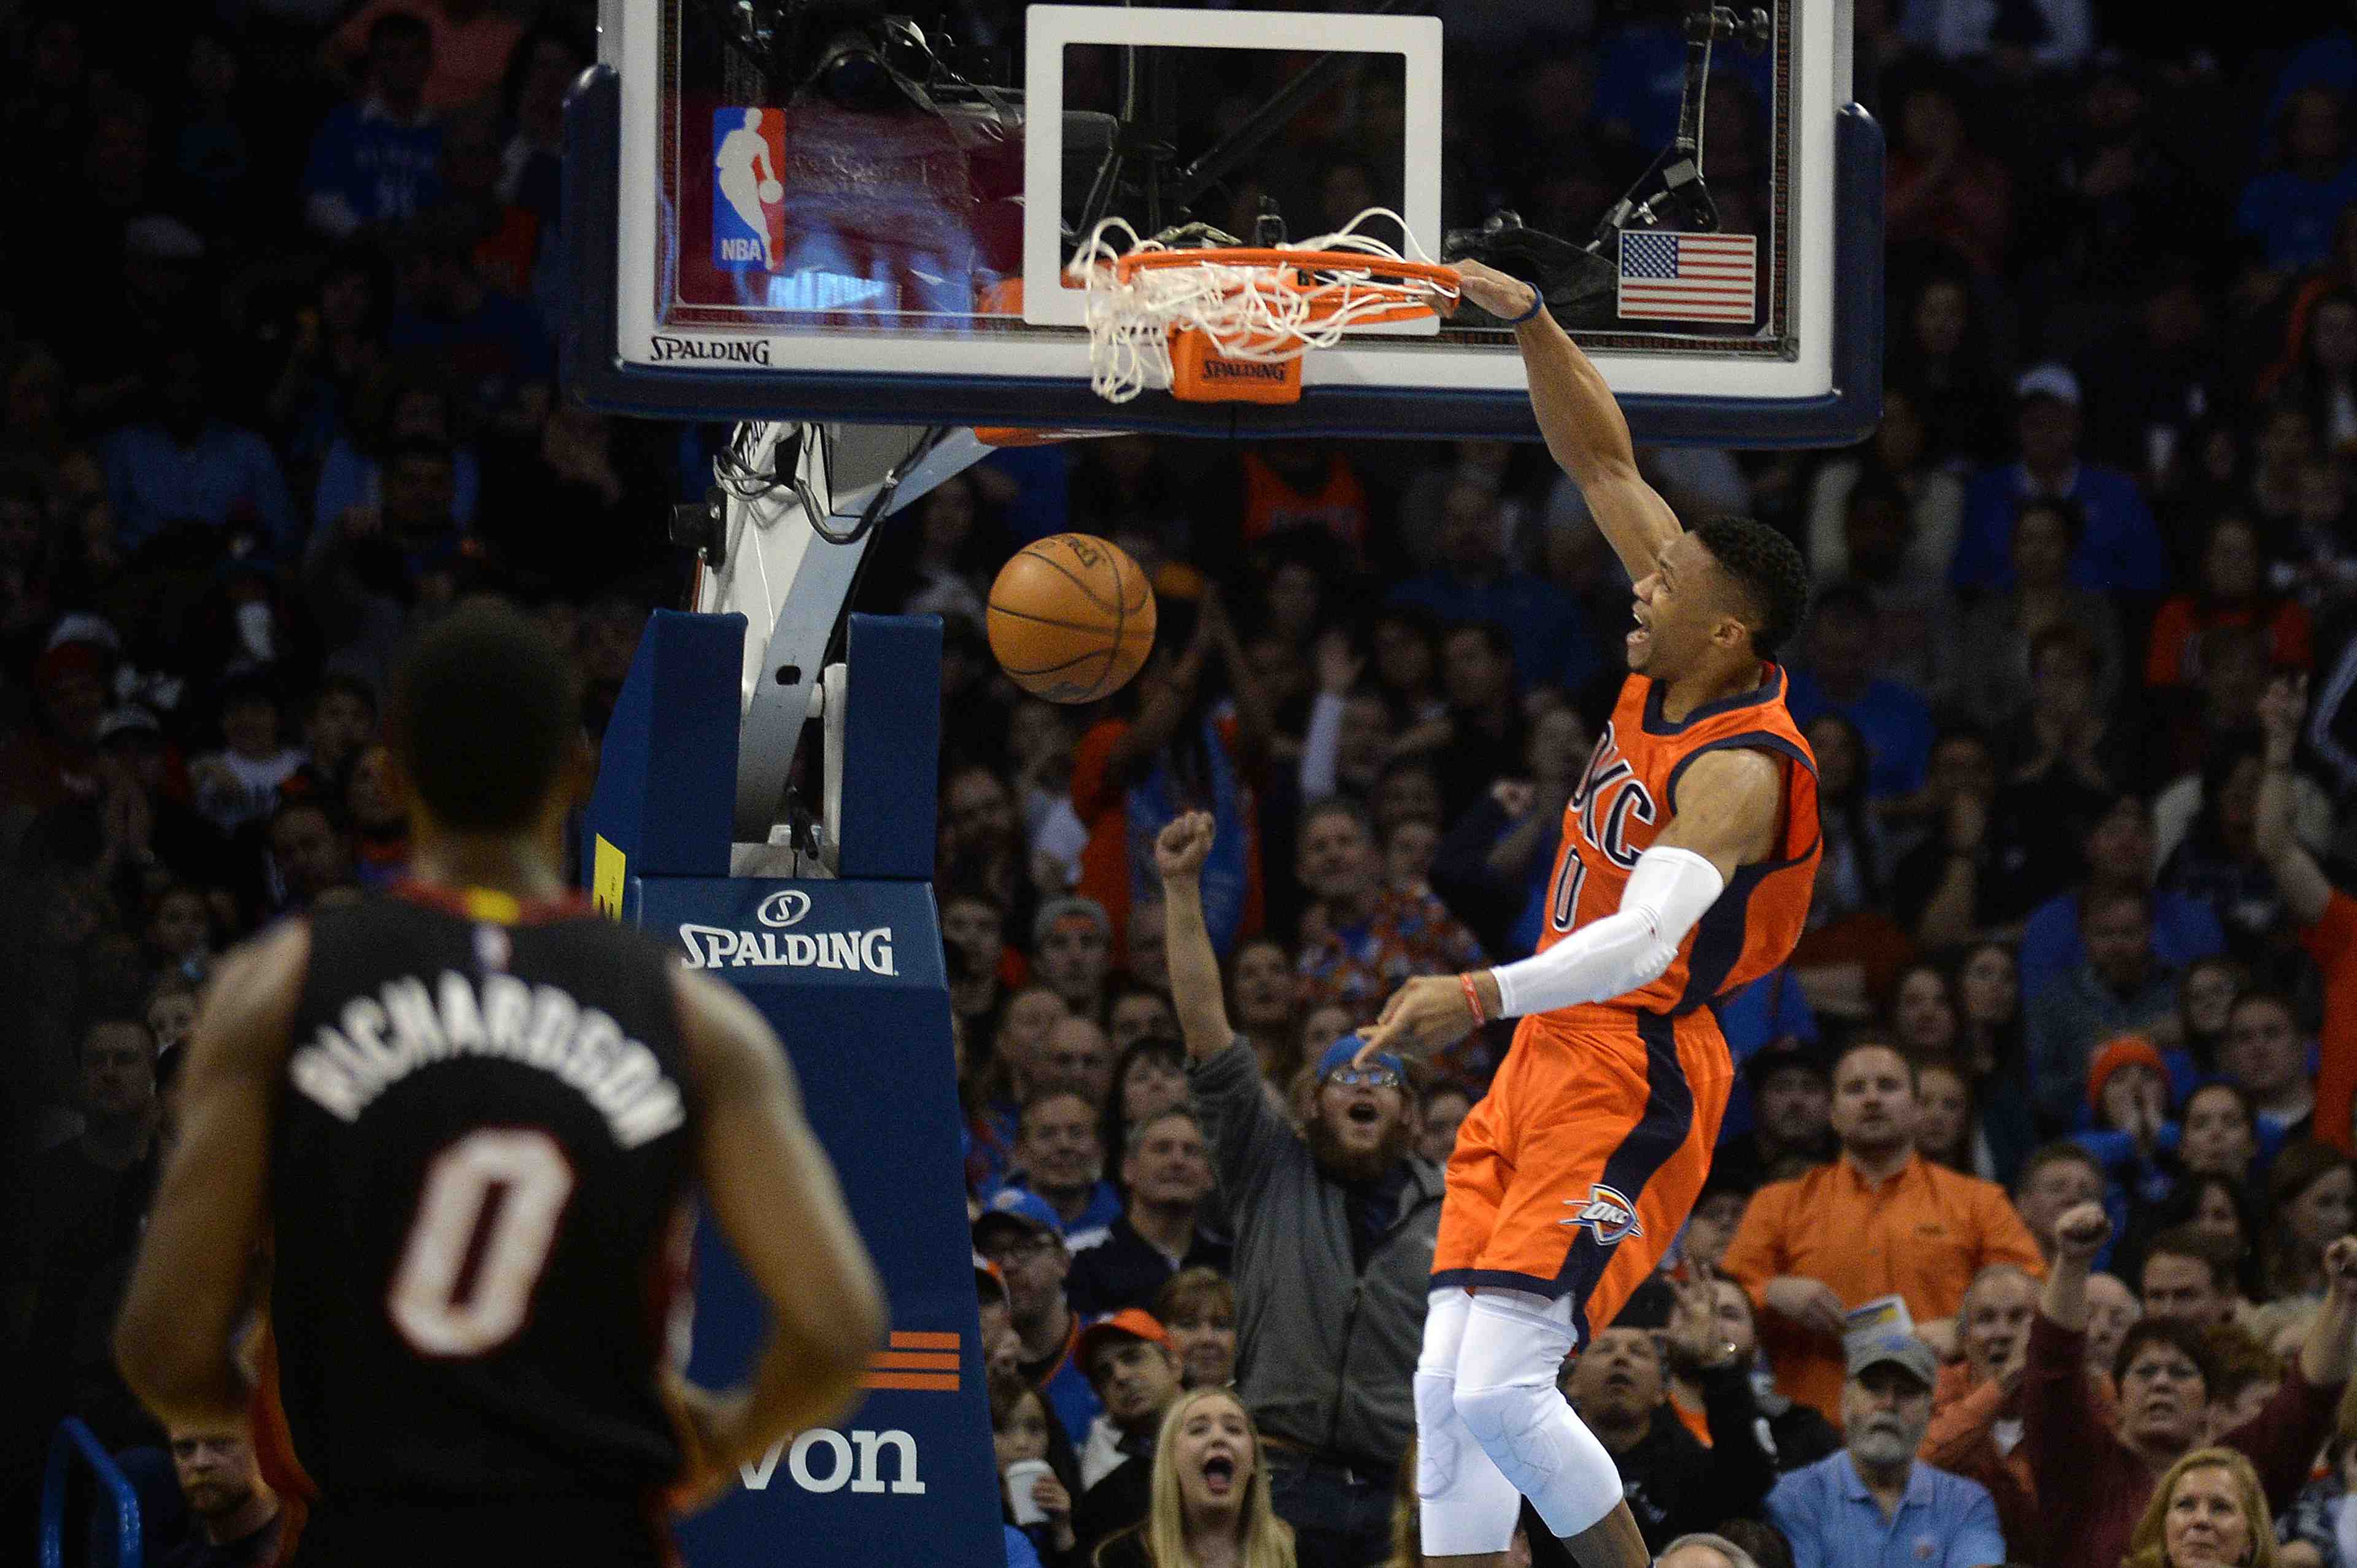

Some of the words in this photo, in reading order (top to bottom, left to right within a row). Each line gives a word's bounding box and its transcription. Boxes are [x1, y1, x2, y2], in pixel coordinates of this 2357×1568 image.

[722, 239, 764, 261] NBA
[651, 336, 770, 366] SPALDING
[679, 922, 894, 976] SPALDING
[387, 1122, 578, 1358] 0
